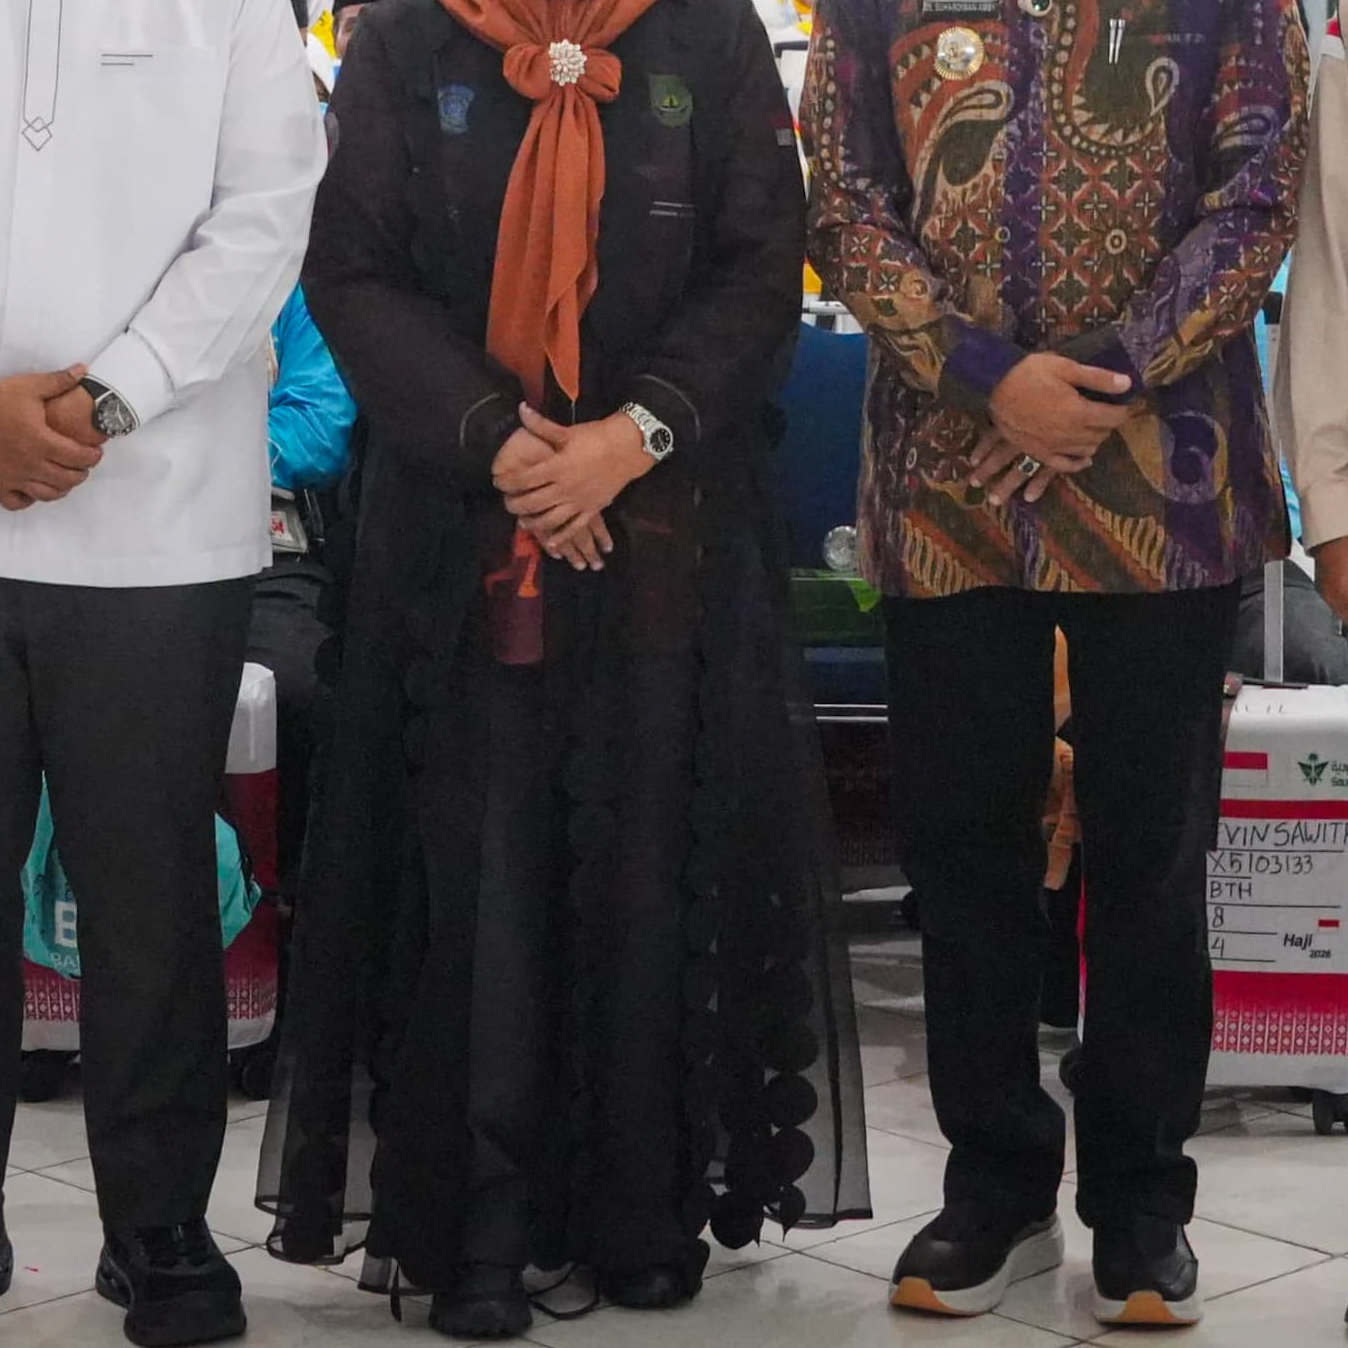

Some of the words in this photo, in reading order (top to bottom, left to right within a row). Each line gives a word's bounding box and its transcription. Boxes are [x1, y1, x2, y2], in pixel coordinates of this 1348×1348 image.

[1207, 851, 1314, 874] X5103133
[1210, 880, 1252, 900] BTH
[1212, 905, 1225, 928] 8
[1211, 936, 1225, 958] 4
[1283, 933, 1314, 950] Haji
